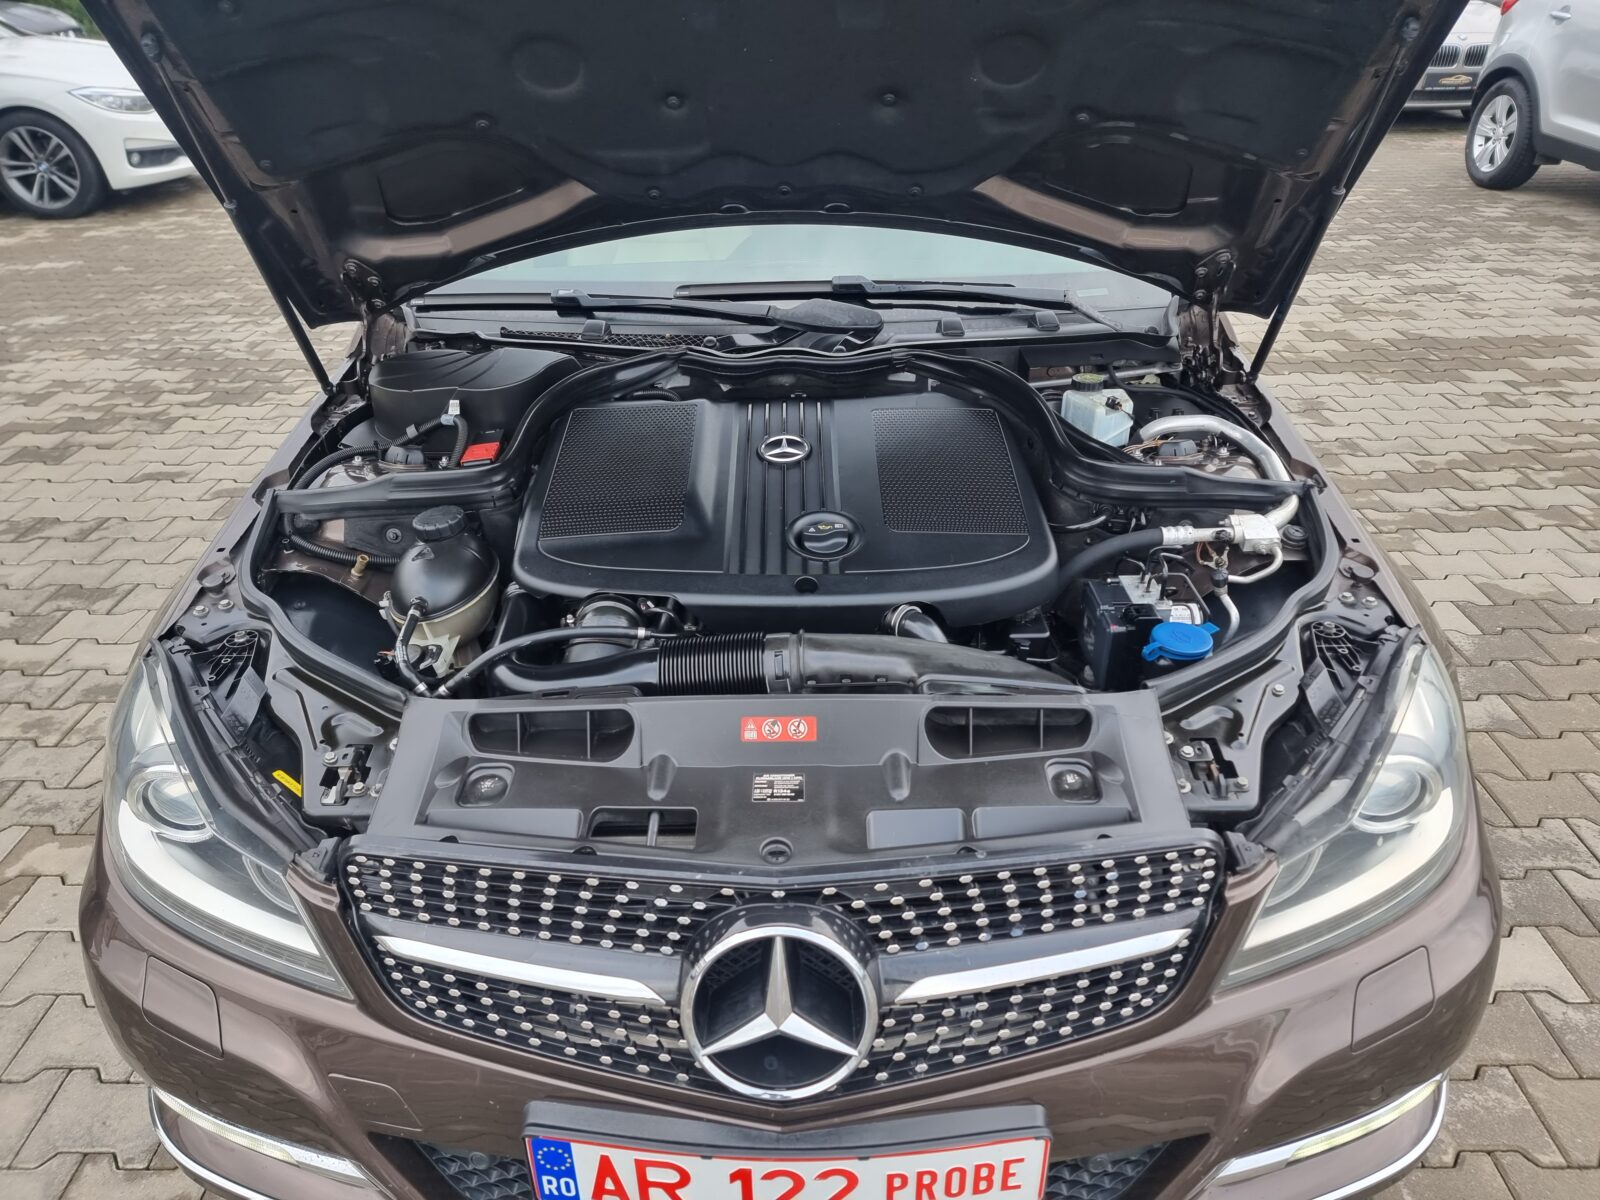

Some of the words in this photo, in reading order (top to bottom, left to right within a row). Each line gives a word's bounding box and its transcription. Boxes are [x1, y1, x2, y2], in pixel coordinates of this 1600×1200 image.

[541, 1175, 577, 1197] RO
[591, 1154, 692, 1200] AR
[729, 1168, 859, 1200] 122
[886, 1157, 1025, 1200] PROBE
